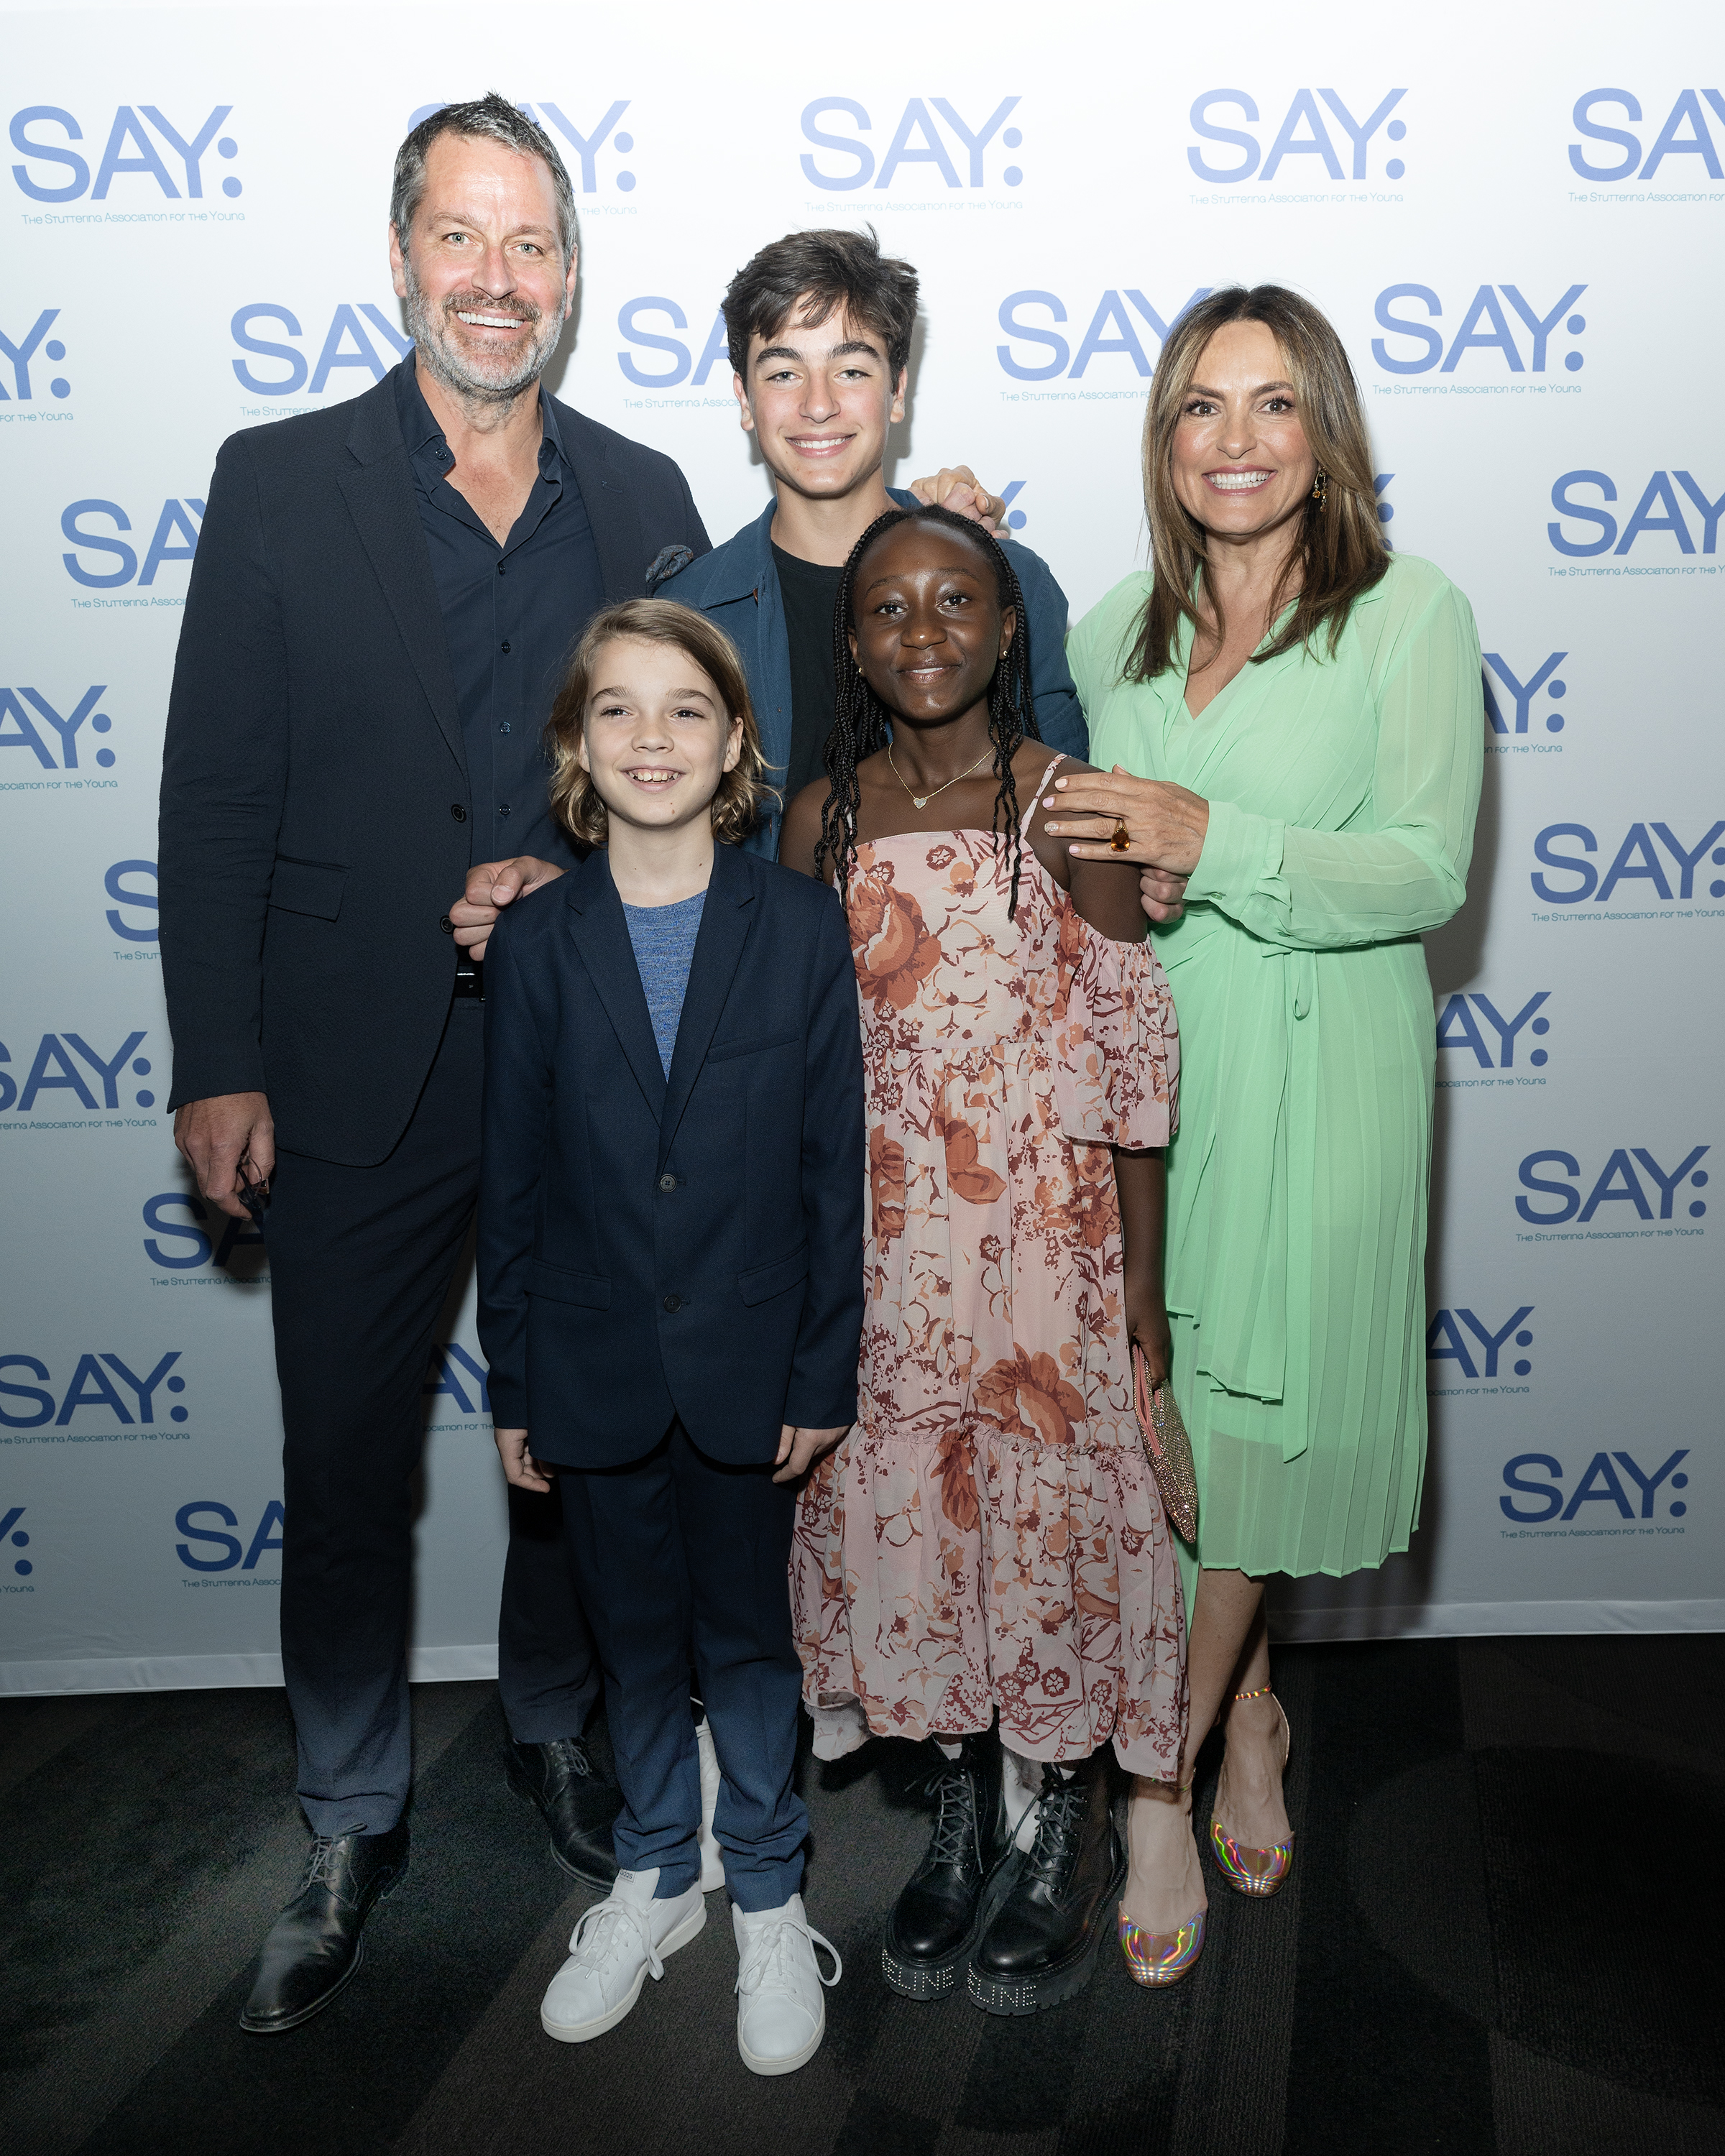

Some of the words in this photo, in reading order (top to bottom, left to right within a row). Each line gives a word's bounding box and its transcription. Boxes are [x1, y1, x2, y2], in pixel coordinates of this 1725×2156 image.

[9, 105, 242, 203] SAY:
[799, 96, 1024, 192] SAY:
[1187, 88, 1408, 184] SAY:
[996, 287, 1214, 382] SAY
[1371, 283, 1588, 375] SAY:
[702, 397, 740, 407] Associa
[60, 498, 206, 589] SA
[1547, 469, 1725, 558] SAY
[0, 685, 116, 770] AY:
[1530, 820, 1725, 904] SAY:
[1435, 991, 1552, 1069] AY:
[1514, 1145, 1710, 1225] SAY:
[142, 1192, 264, 1270] SA
[1426, 1306, 1535, 1378] AY:
[0, 1351, 188, 1428] SAY:
[1499, 1449, 1690, 1524] SAY:
[175, 1500, 285, 1572] SA
